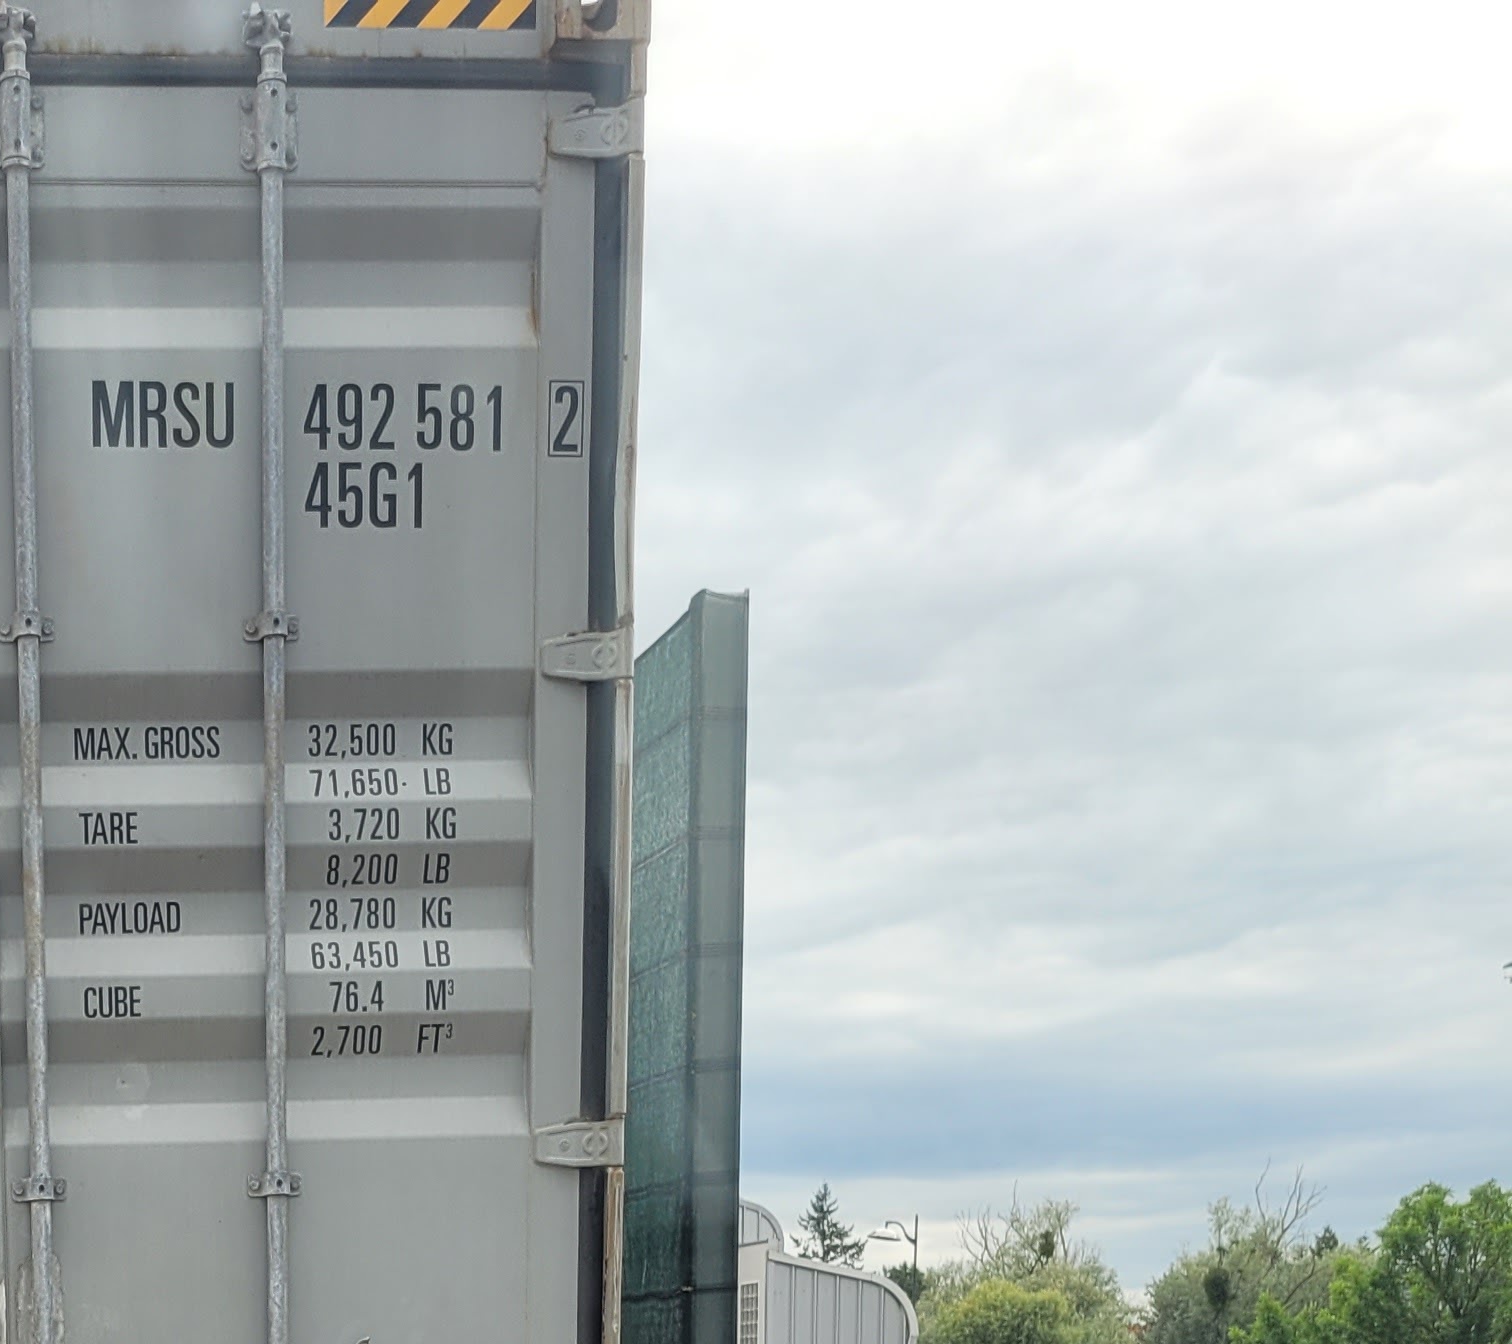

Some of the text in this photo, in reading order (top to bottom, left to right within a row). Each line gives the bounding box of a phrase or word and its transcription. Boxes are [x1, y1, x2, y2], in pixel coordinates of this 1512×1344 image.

[91, 380, 579, 453] MRSU 492 581 2
[304, 461, 424, 529] 45G1
[73, 722, 454, 760] MAX. GROSS 32,500 KG
[309, 767, 452, 798] 71,650 LB
[79, 806, 458, 845] TARE 3,720 KG
[326, 852, 451, 888] 8,200 LB
[79, 896, 453, 935] PAYLOAD 28,780 KG
[310, 939, 452, 972] 63,450 LB
[83, 985, 142, 1018] CUBE
[329, 980, 385, 1013] 76.4
[311, 1024, 383, 1058] 2,700
